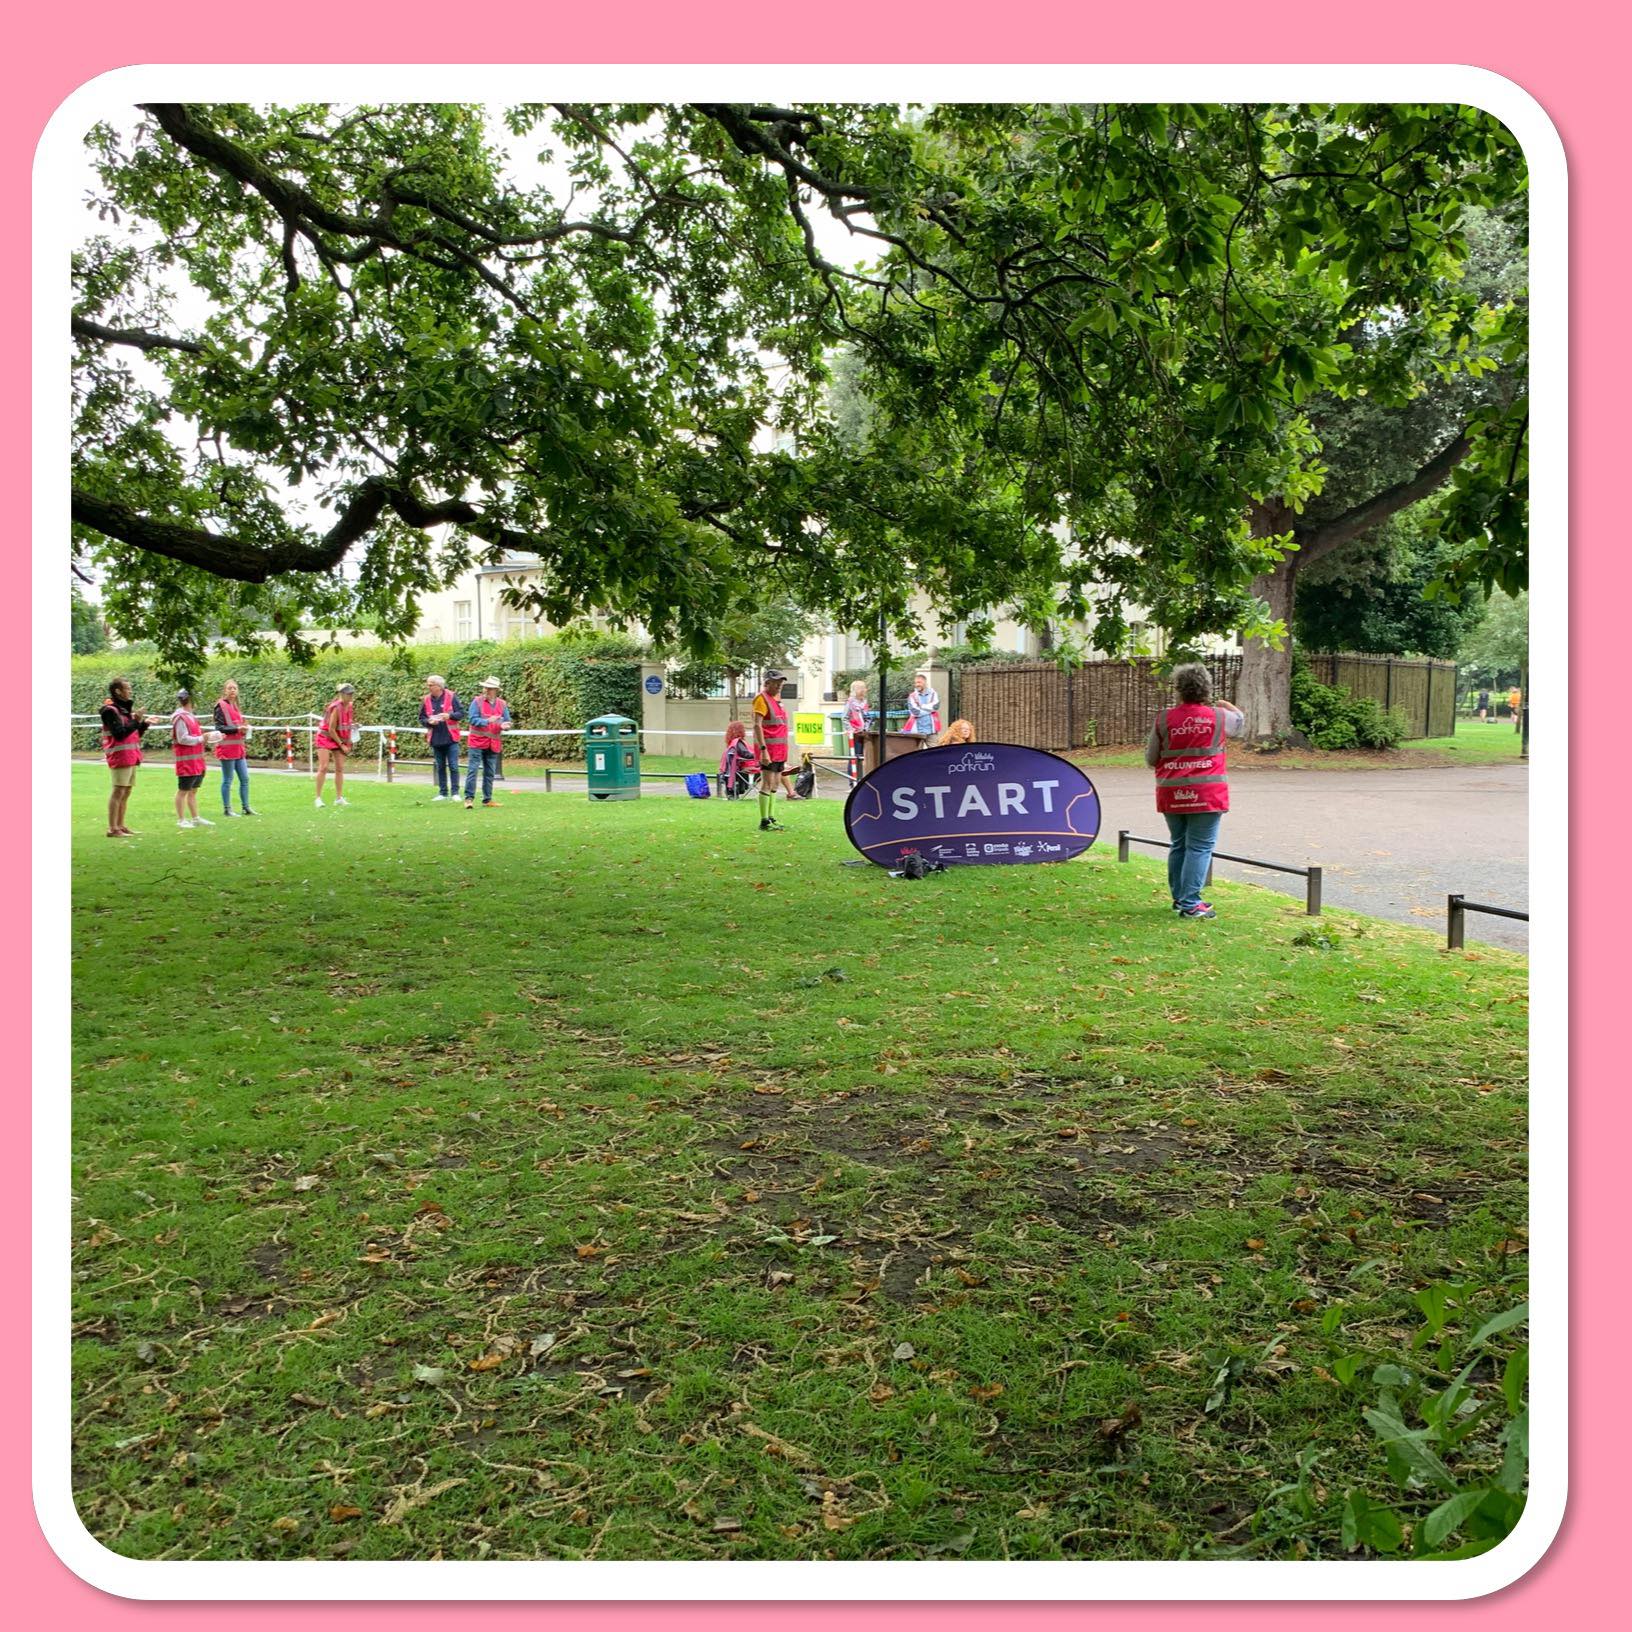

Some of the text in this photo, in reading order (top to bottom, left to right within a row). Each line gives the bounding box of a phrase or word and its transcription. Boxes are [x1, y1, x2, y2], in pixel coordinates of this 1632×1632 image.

[796, 723, 823, 734] FINISH
[948, 758, 995, 774] parkrun
[1164, 760, 1214, 769] VOLUNTEER
[891, 779, 1060, 821] START
